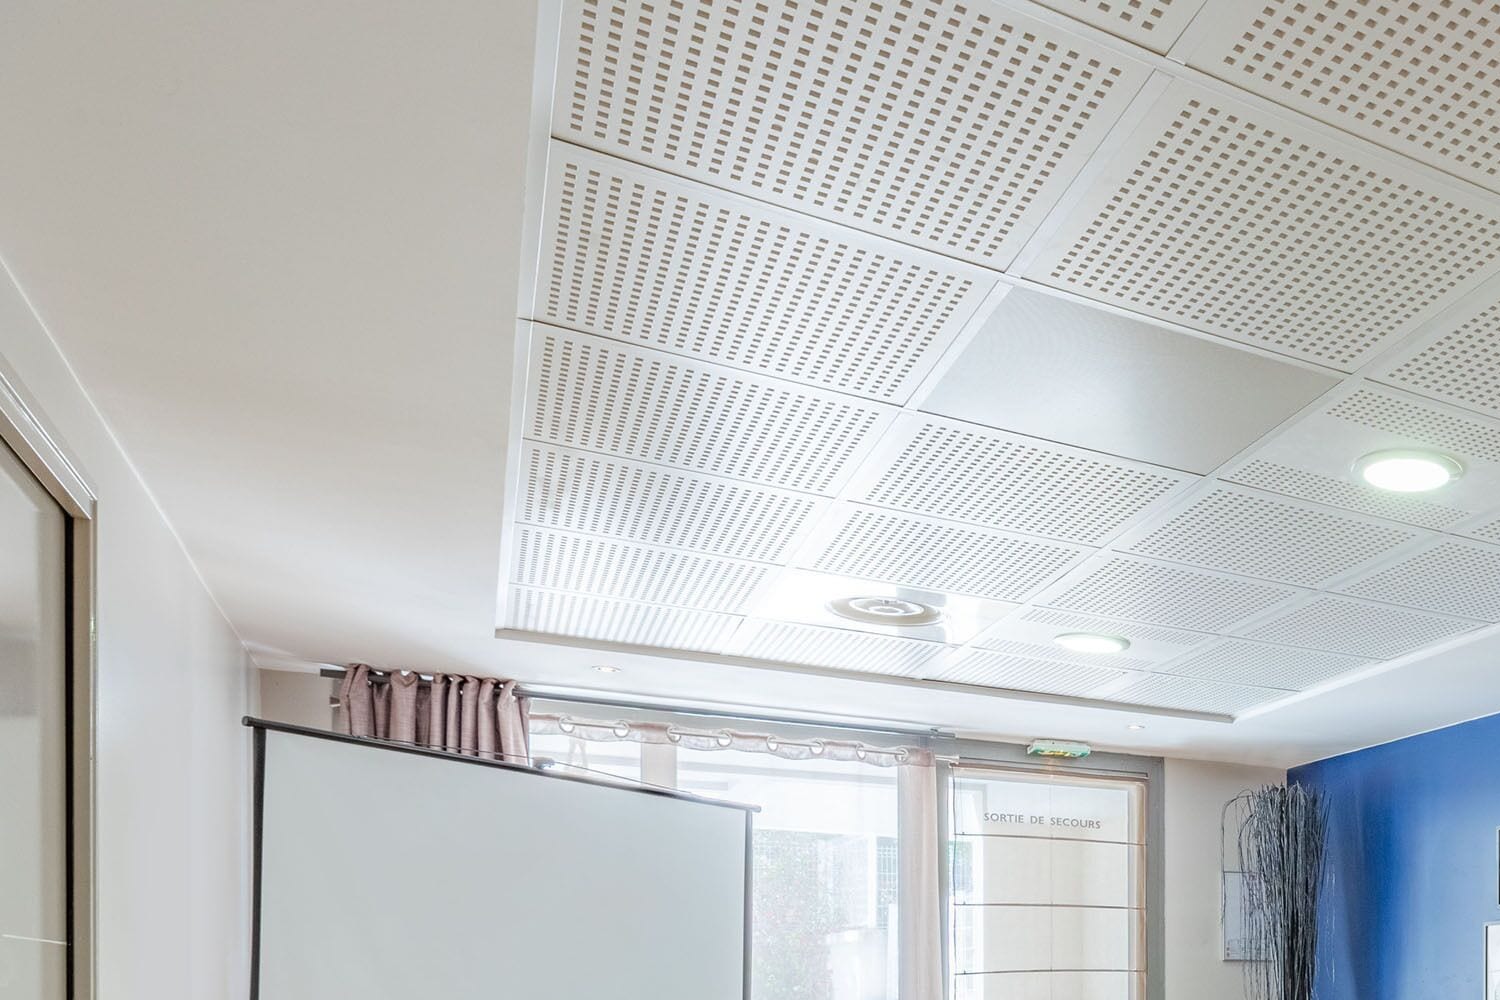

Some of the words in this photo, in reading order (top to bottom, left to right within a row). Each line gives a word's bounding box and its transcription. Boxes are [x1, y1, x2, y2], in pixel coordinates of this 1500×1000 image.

[984, 812, 1024, 824] SORTIE
[1030, 816, 1044, 825] DE
[1050, 817, 1101, 829] SECOURS
